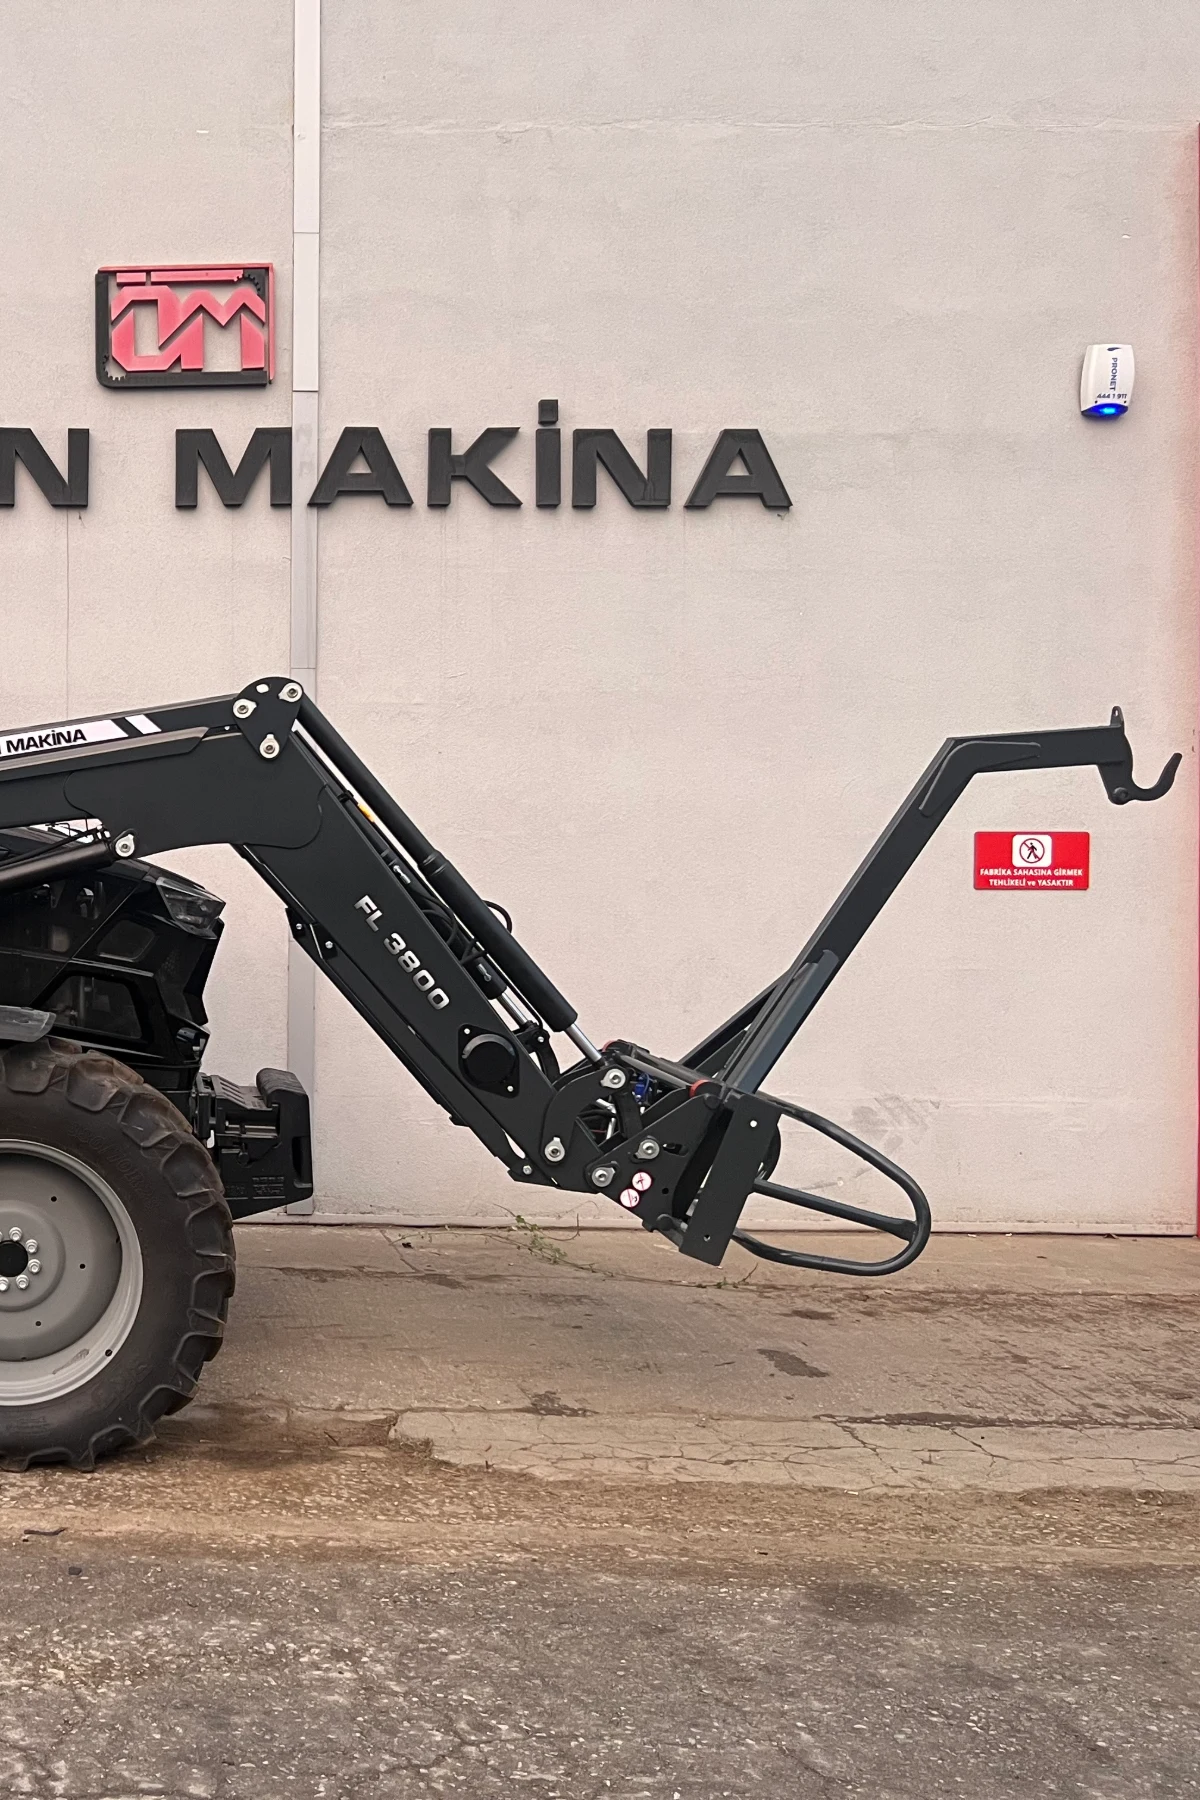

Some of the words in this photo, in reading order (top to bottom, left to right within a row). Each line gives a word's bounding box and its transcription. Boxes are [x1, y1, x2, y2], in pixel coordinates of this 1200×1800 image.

[1109, 357, 1118, 391] PRONET
[175, 398, 794, 509] MAKİNA
[6, 729, 87, 753] MAKİNA
[979, 868, 1012, 876] FABRİKA
[1013, 868, 1052, 876] SAHASINA
[1053, 867, 1083, 876] GİRMEK
[989, 878, 1026, 887] TEHLİKELİ
[1037, 879, 1074, 887] YASAKTIR
[354, 895, 383, 932] FL
[383, 932, 450, 1010] 3800
